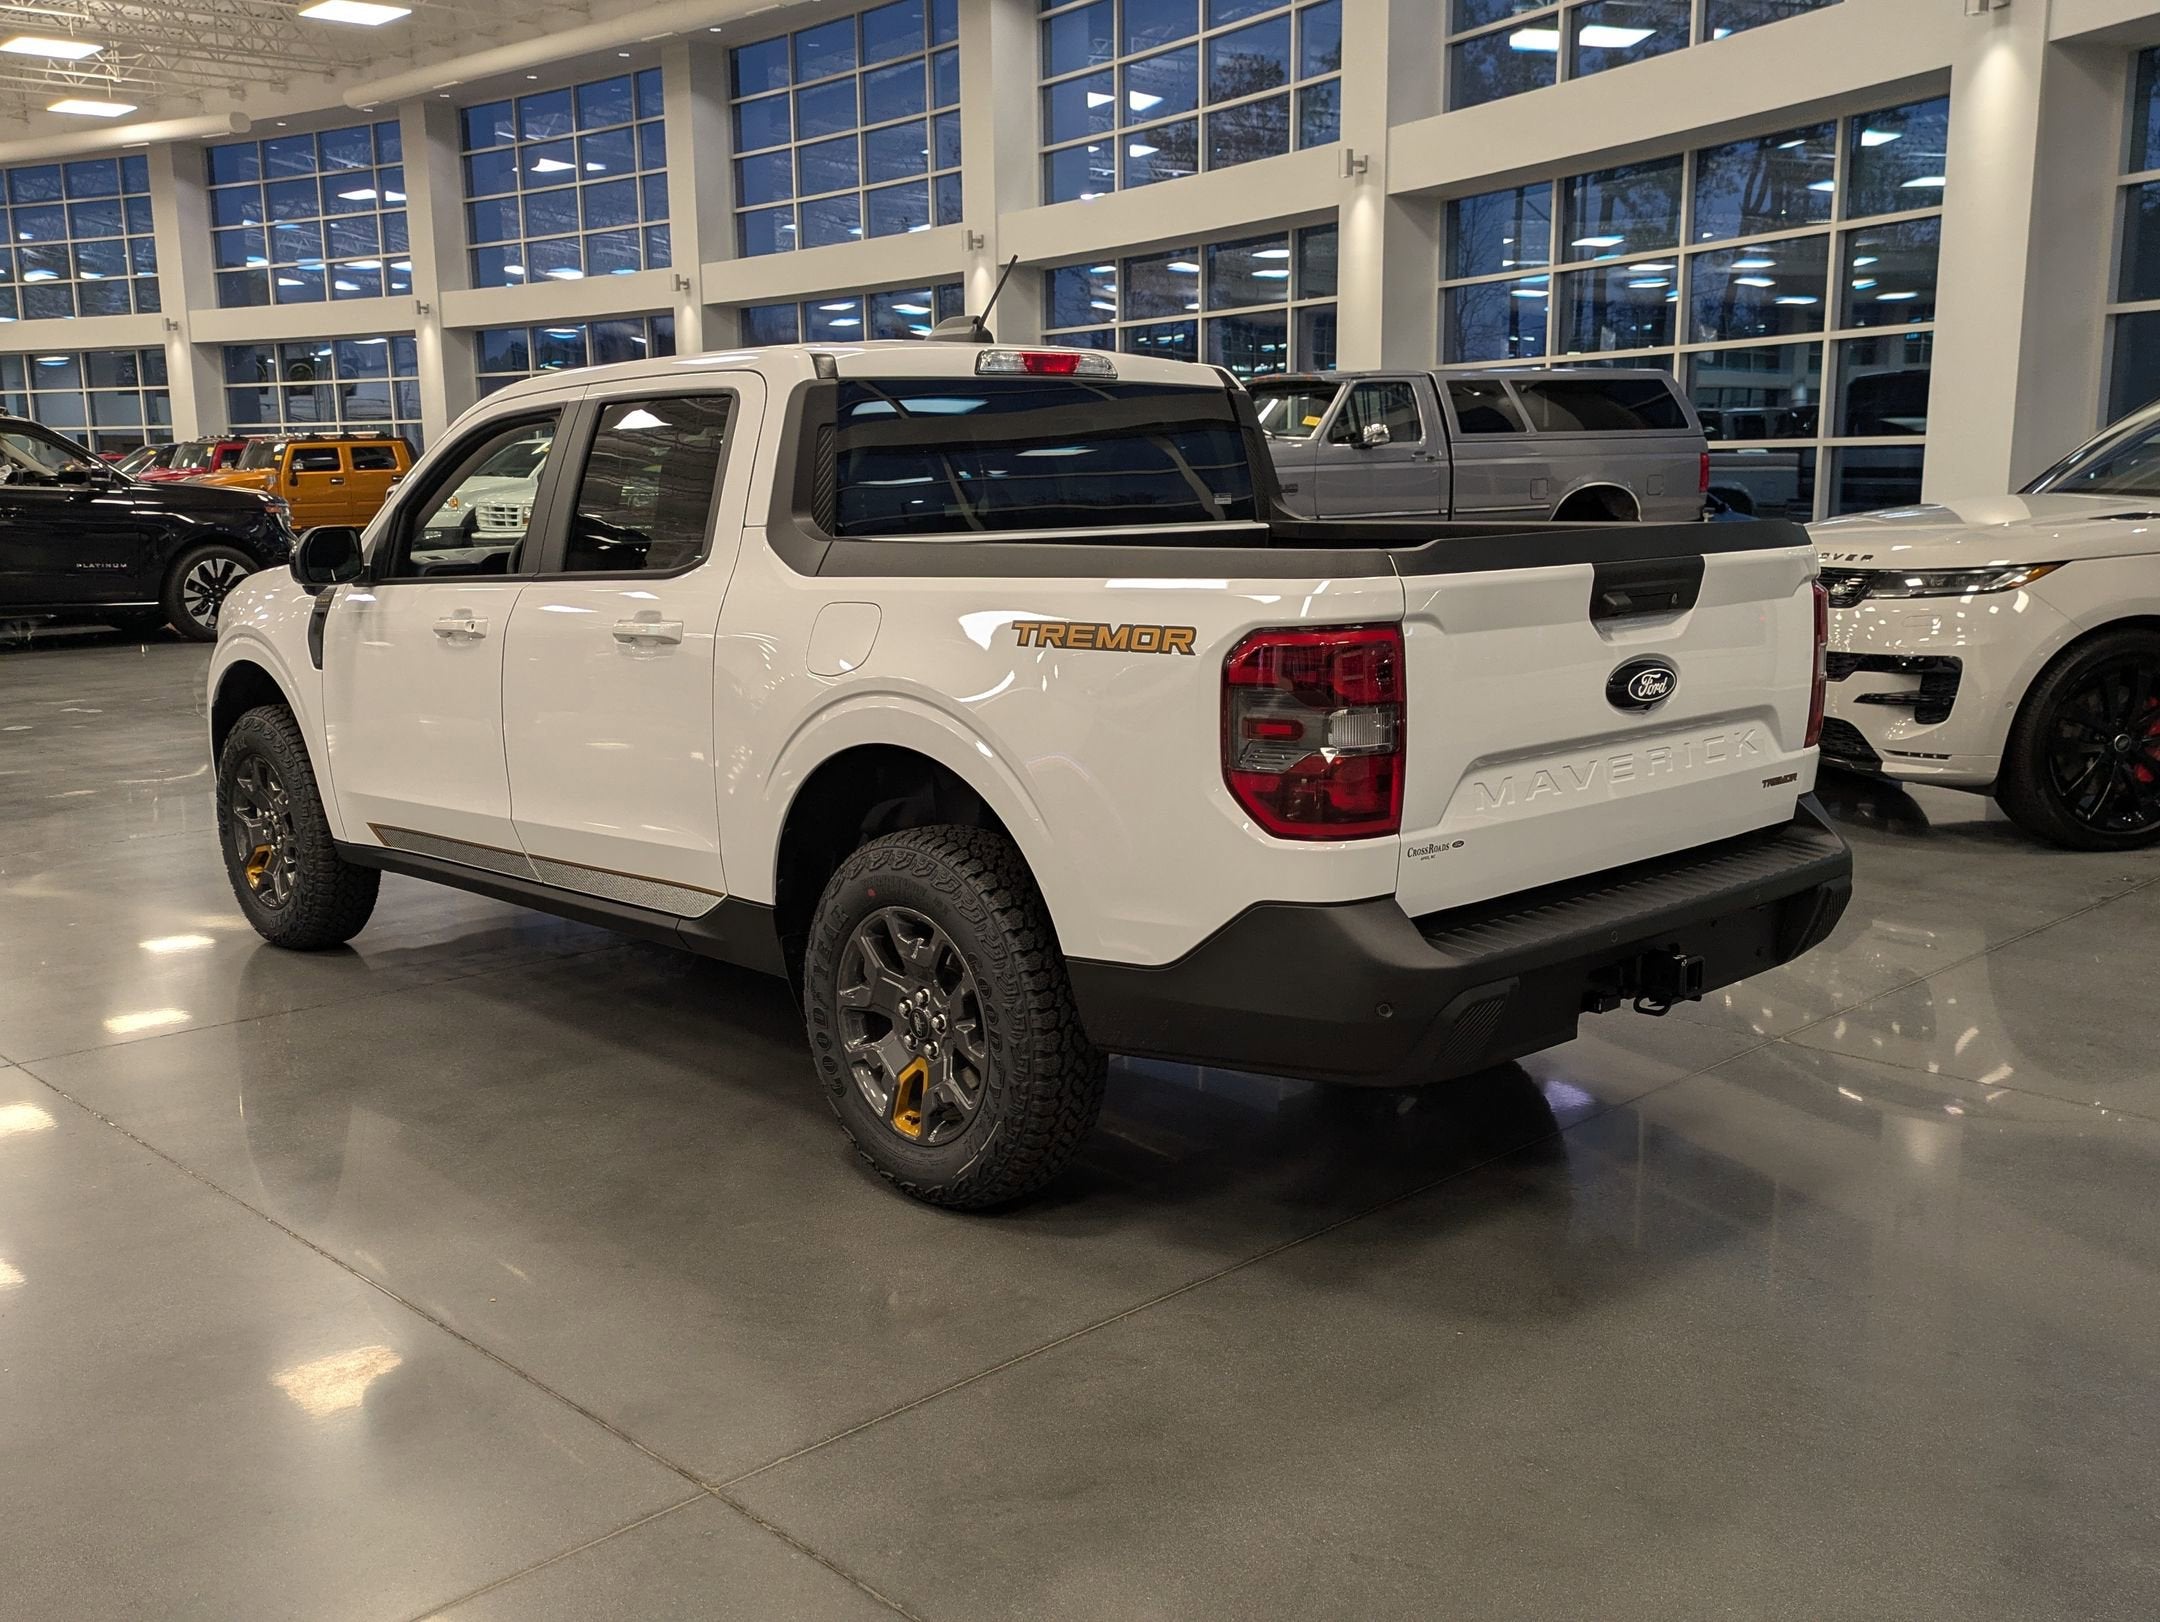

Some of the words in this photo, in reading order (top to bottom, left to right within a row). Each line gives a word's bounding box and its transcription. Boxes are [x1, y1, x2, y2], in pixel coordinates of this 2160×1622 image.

[1011, 620, 1197, 656] TREMOR
[1636, 672, 1670, 699] Ford
[1473, 728, 1759, 811] MAVERICK
[1761, 772, 1798, 789] TREMOR
